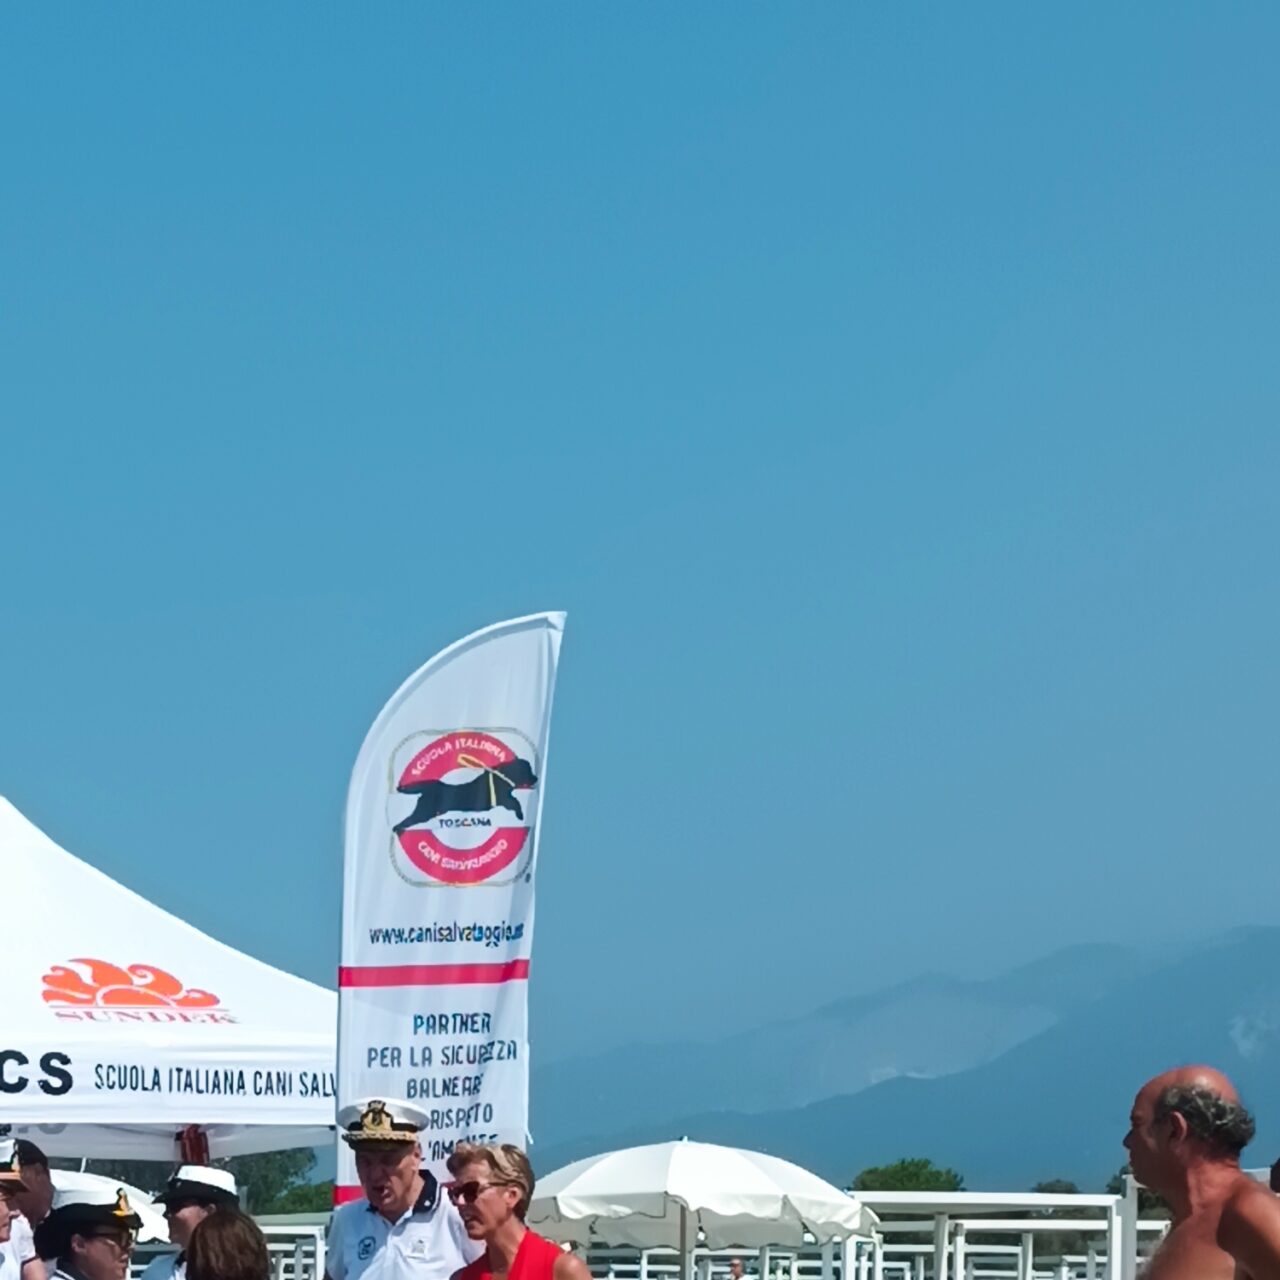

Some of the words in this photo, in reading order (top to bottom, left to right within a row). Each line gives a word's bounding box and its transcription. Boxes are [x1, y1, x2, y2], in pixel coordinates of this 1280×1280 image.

[413, 1012, 492, 1036] PARTNER
[367, 1046, 402, 1068] PER
[409, 1046, 433, 1068] LA
[94, 1063, 162, 1092] SCUOLA
[168, 1067, 247, 1096] ITALIANA
[253, 1070, 293, 1097] CANI
